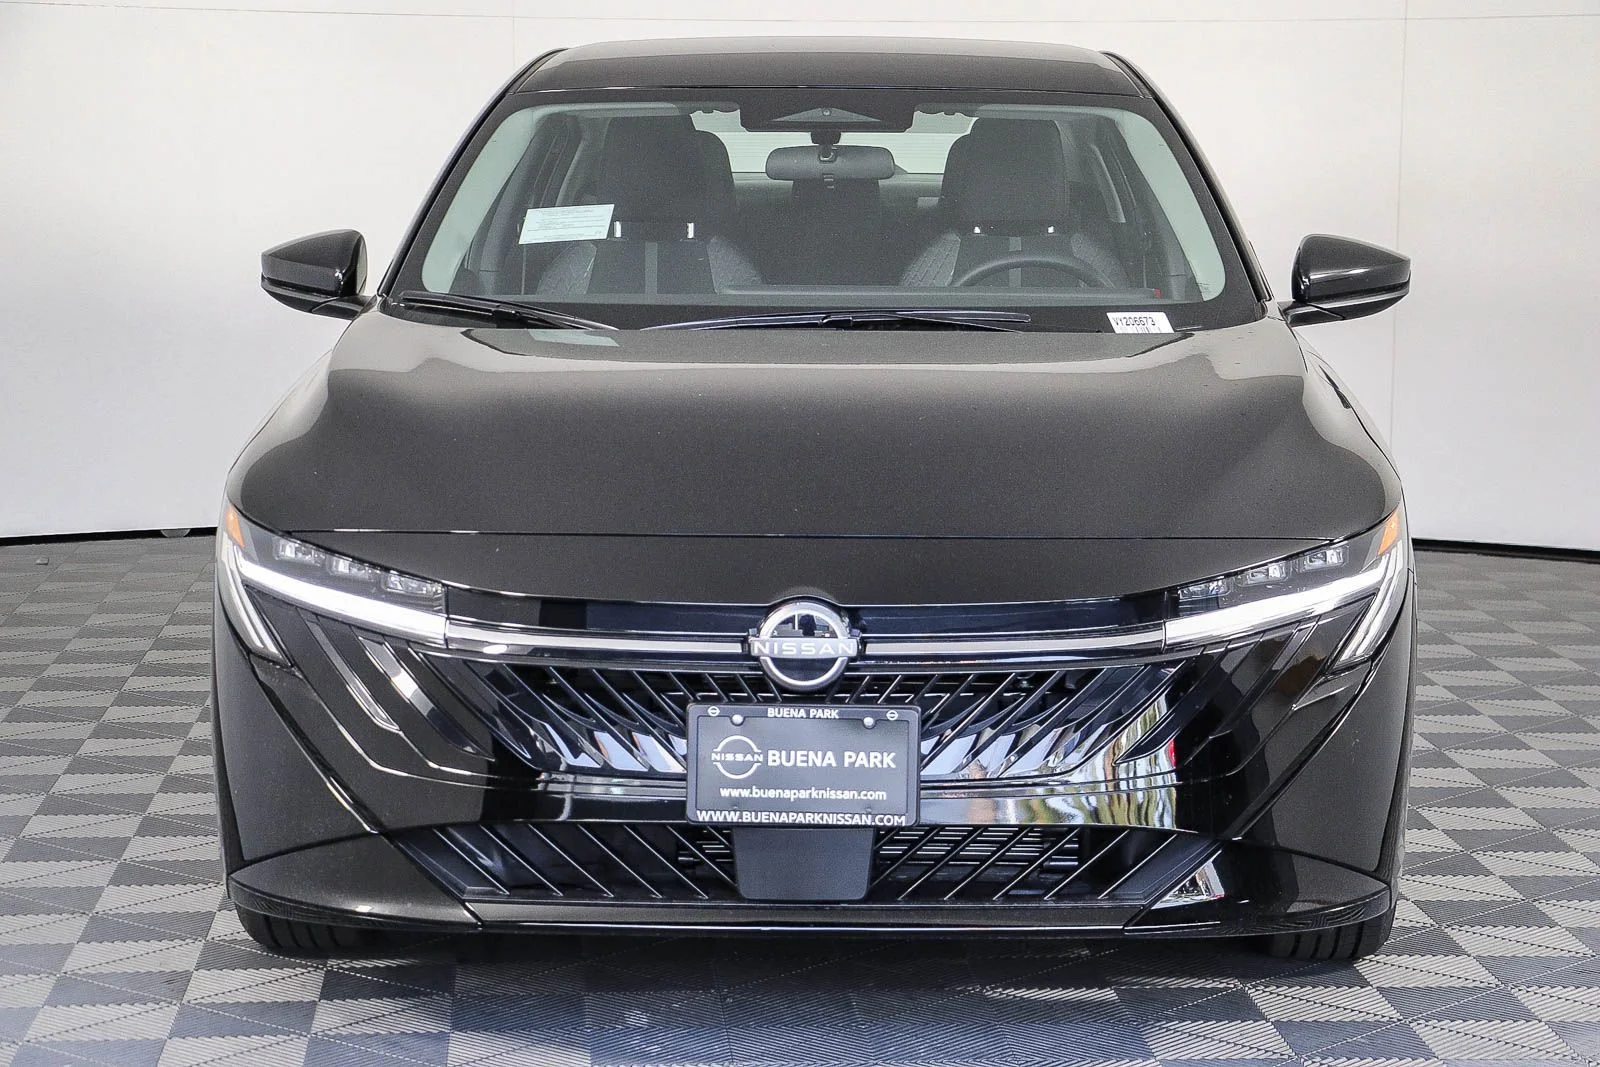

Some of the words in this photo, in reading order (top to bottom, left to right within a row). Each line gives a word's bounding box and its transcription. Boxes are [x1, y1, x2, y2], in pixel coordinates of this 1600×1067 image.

[753, 642, 855, 655] NISSAN
[767, 707, 807, 719] BUENA
[809, 708, 840, 719] PARK
[711, 752, 764, 762] NISSAN
[767, 750, 837, 767] BUENA
[843, 751, 897, 769] PARK
[719, 785, 888, 802] www.buenaparknissan.com
[696, 809, 906, 827] WWW.BUENAPARKNISSAN.COM
